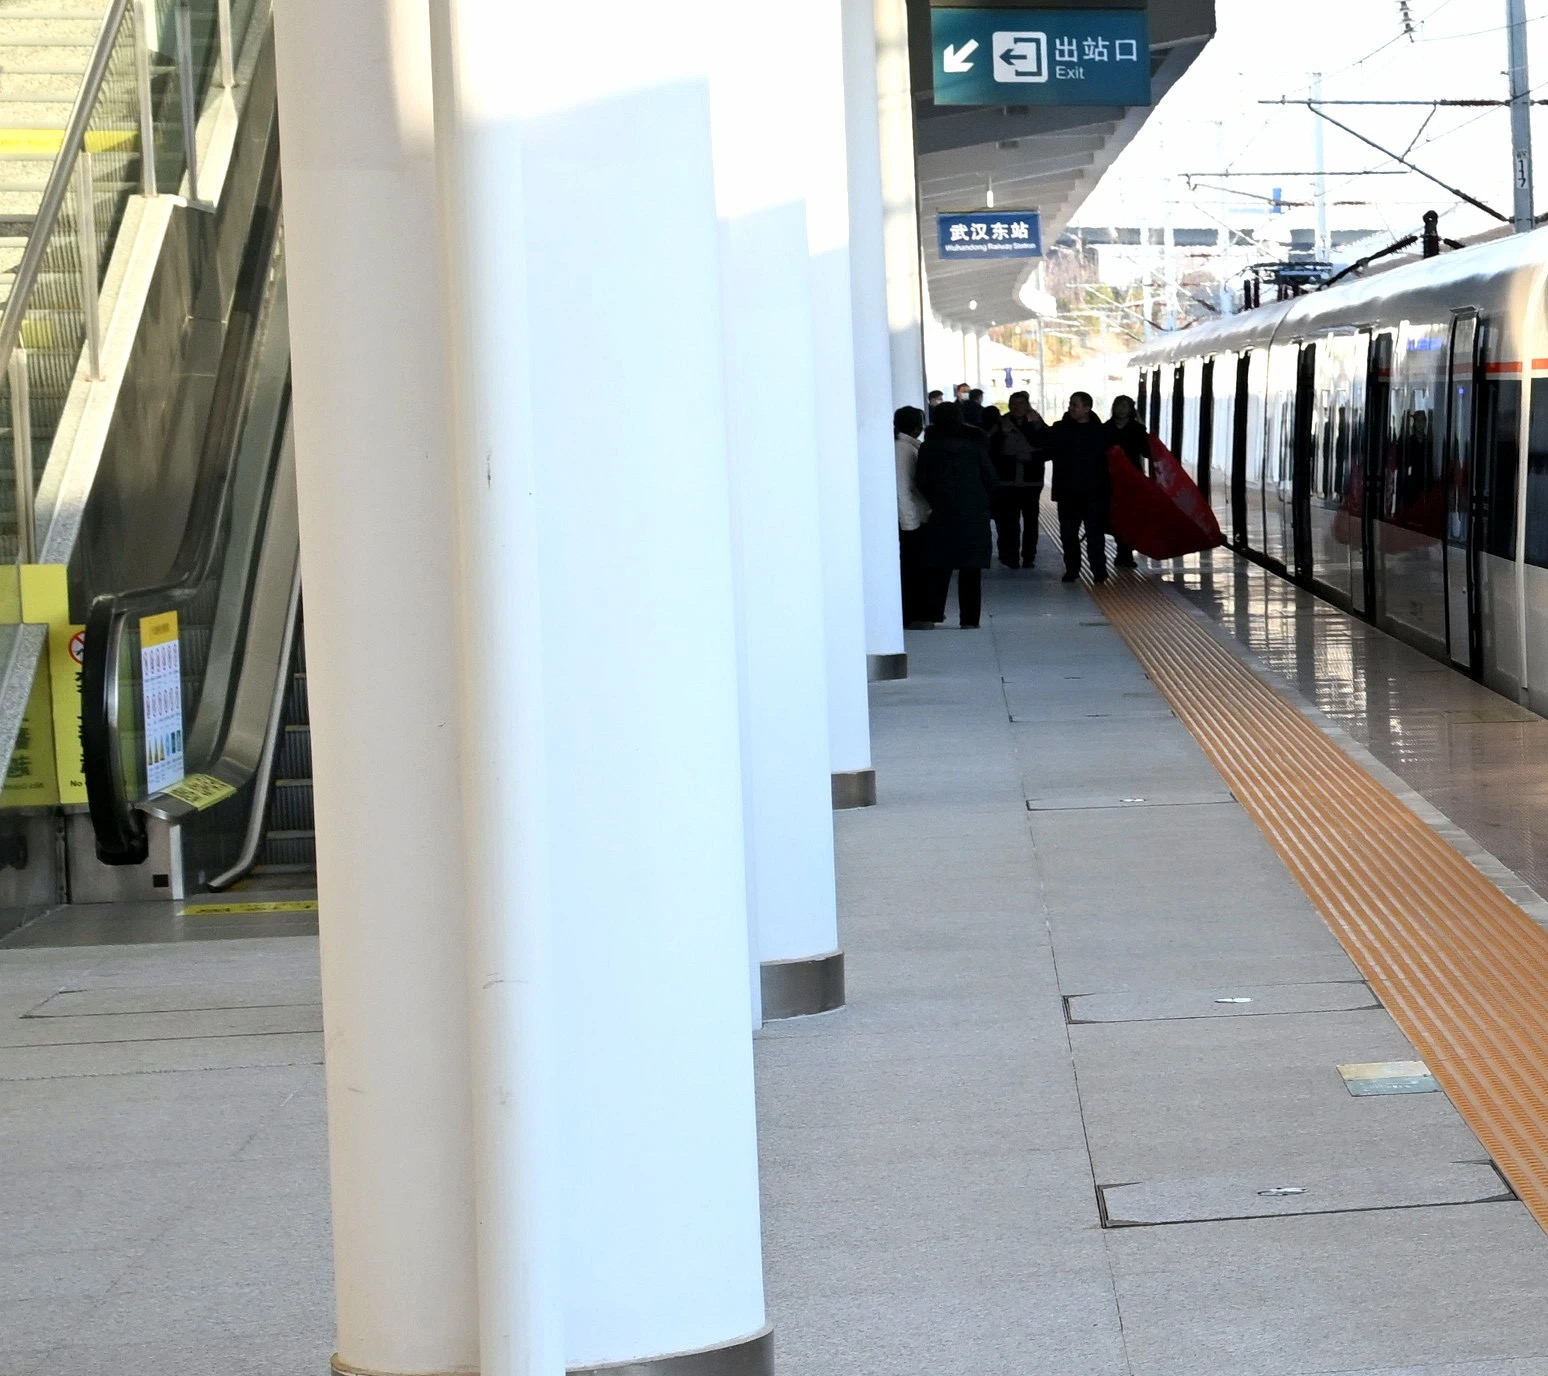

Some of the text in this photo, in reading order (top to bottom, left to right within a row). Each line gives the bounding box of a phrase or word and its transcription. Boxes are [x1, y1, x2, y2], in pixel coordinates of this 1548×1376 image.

[1055, 36, 1137, 62] 出站口
[1056, 65, 1085, 80] Exit
[949, 221, 1029, 241] 武汉东站
